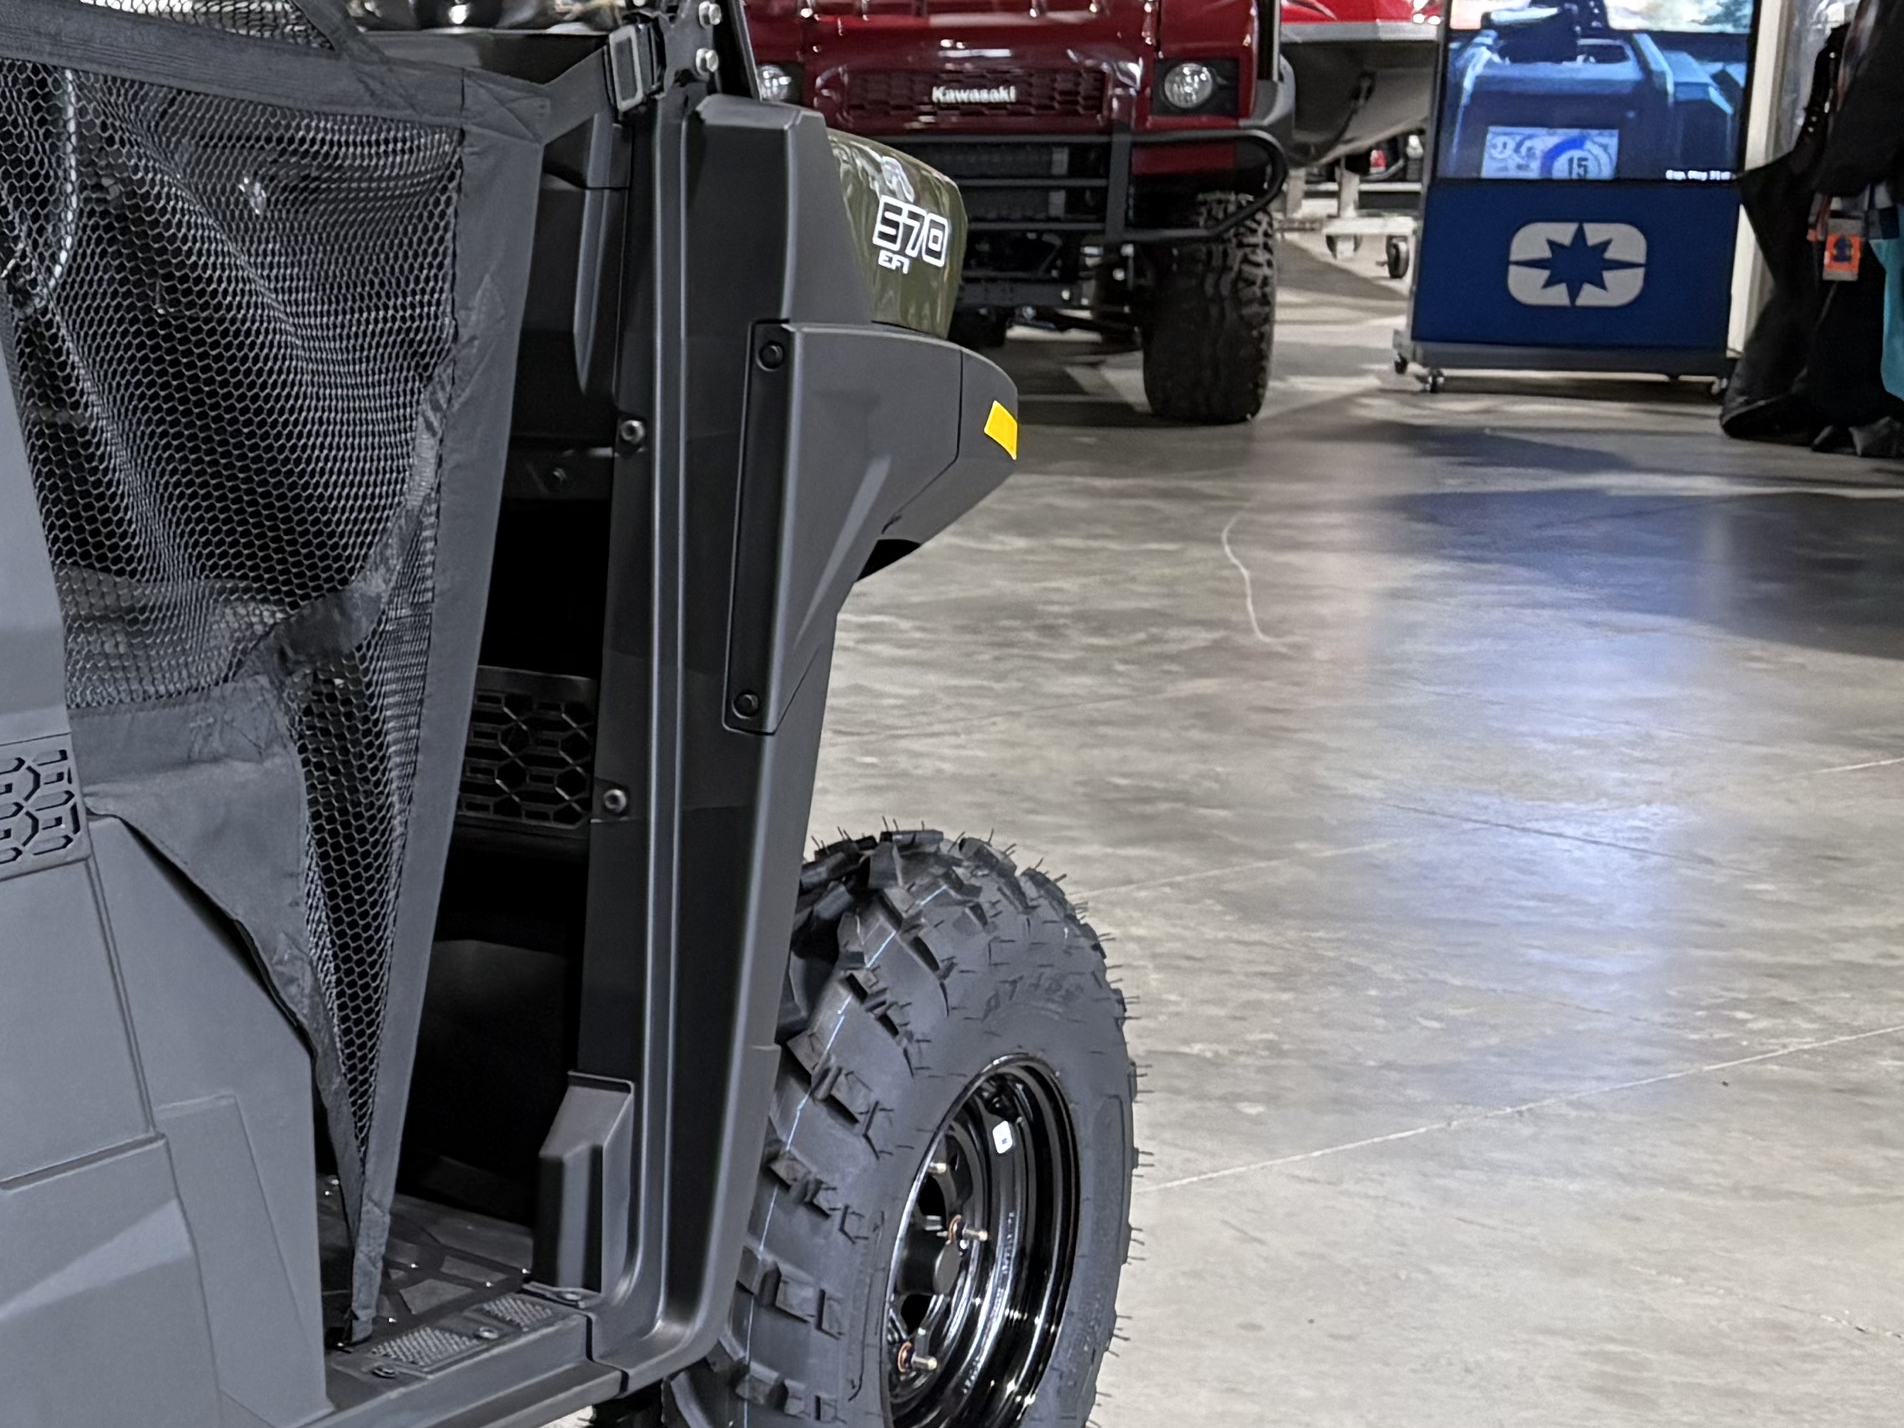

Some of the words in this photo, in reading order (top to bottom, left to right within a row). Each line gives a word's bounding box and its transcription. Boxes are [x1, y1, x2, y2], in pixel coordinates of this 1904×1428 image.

[932, 85, 1017, 105] Kawasaki
[873, 196, 950, 268] 570
[878, 249, 910, 274] EFI
